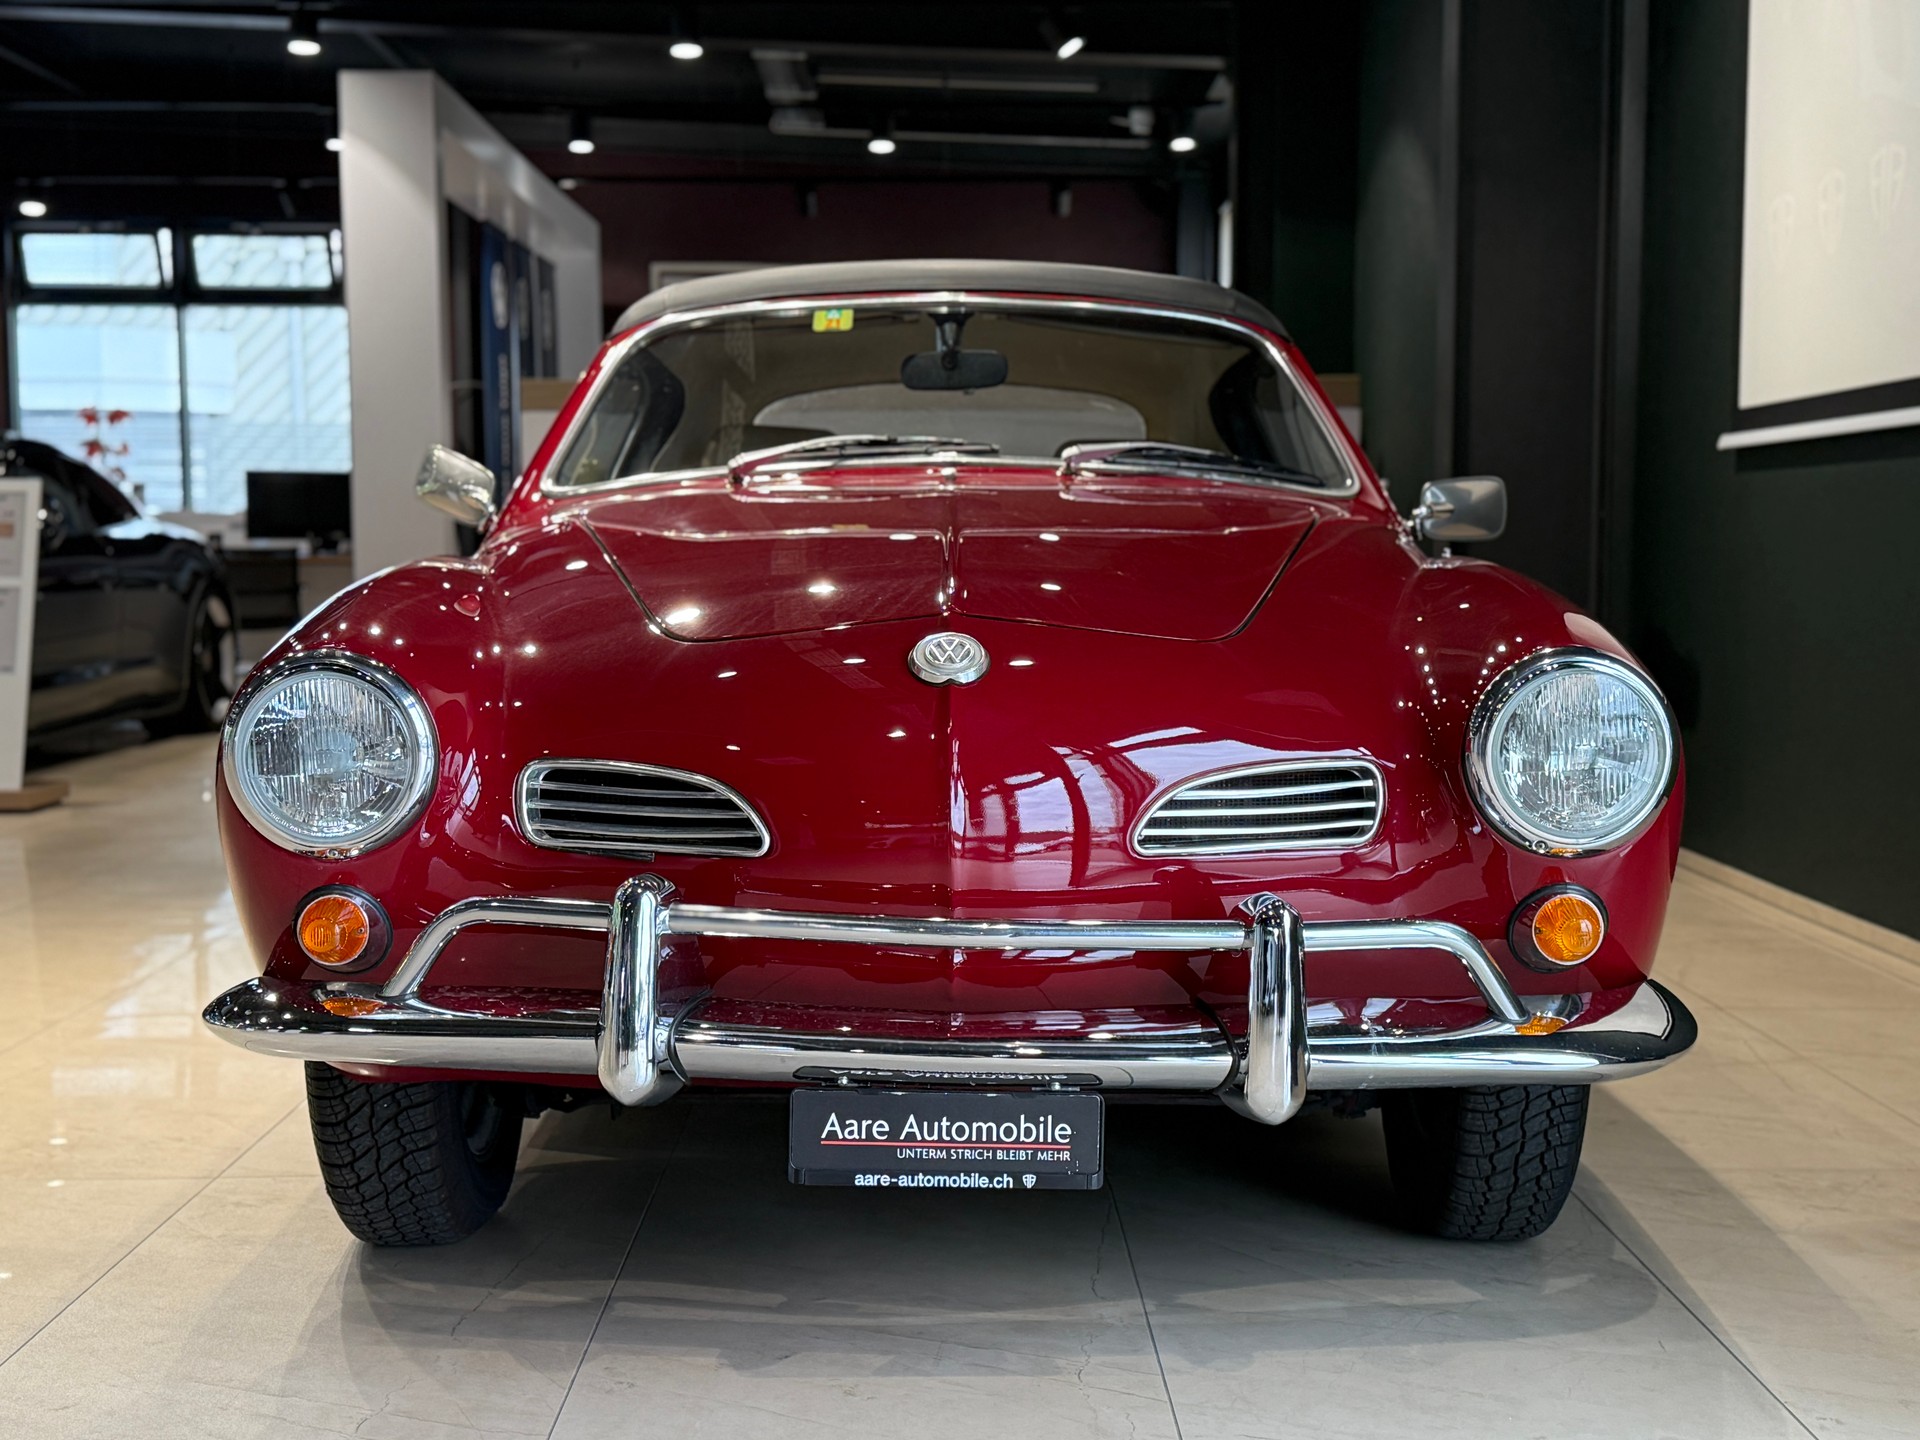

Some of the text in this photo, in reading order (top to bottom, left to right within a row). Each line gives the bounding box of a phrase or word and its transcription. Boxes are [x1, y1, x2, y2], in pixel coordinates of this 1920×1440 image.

[821, 1112, 1072, 1143] Aare Automobile
[897, 1148, 1071, 1161] UNTERM STRICH BLEIBT MEHR
[855, 1173, 1013, 1188] aare-automobile.ch
